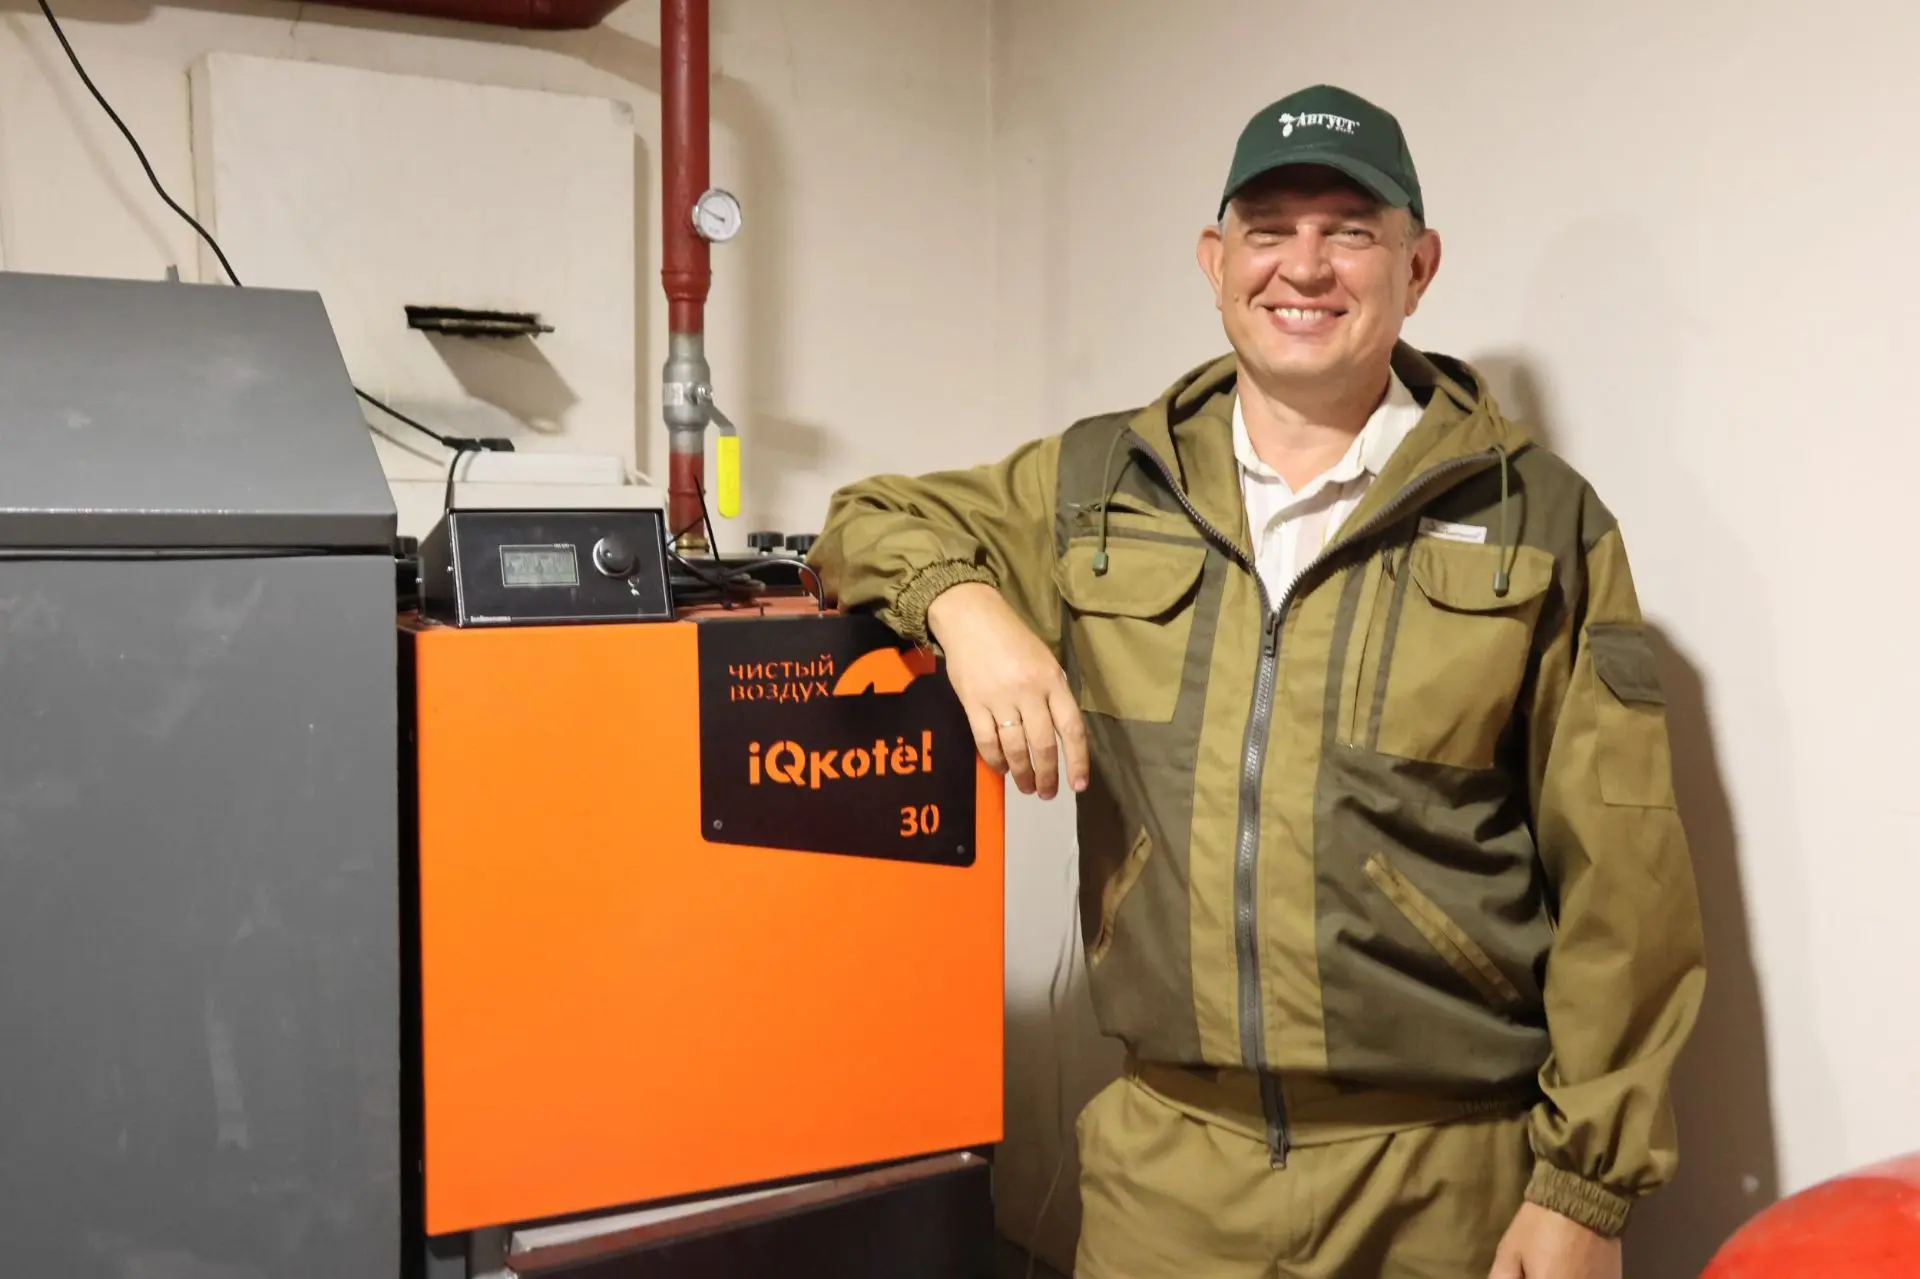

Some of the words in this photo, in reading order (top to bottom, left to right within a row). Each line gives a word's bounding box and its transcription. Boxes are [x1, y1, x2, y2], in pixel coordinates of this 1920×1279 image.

[728, 653, 834, 680] ЧИСТЫЙ
[730, 680, 829, 704] ВОЗДУХ
[900, 804, 940, 837] 30
